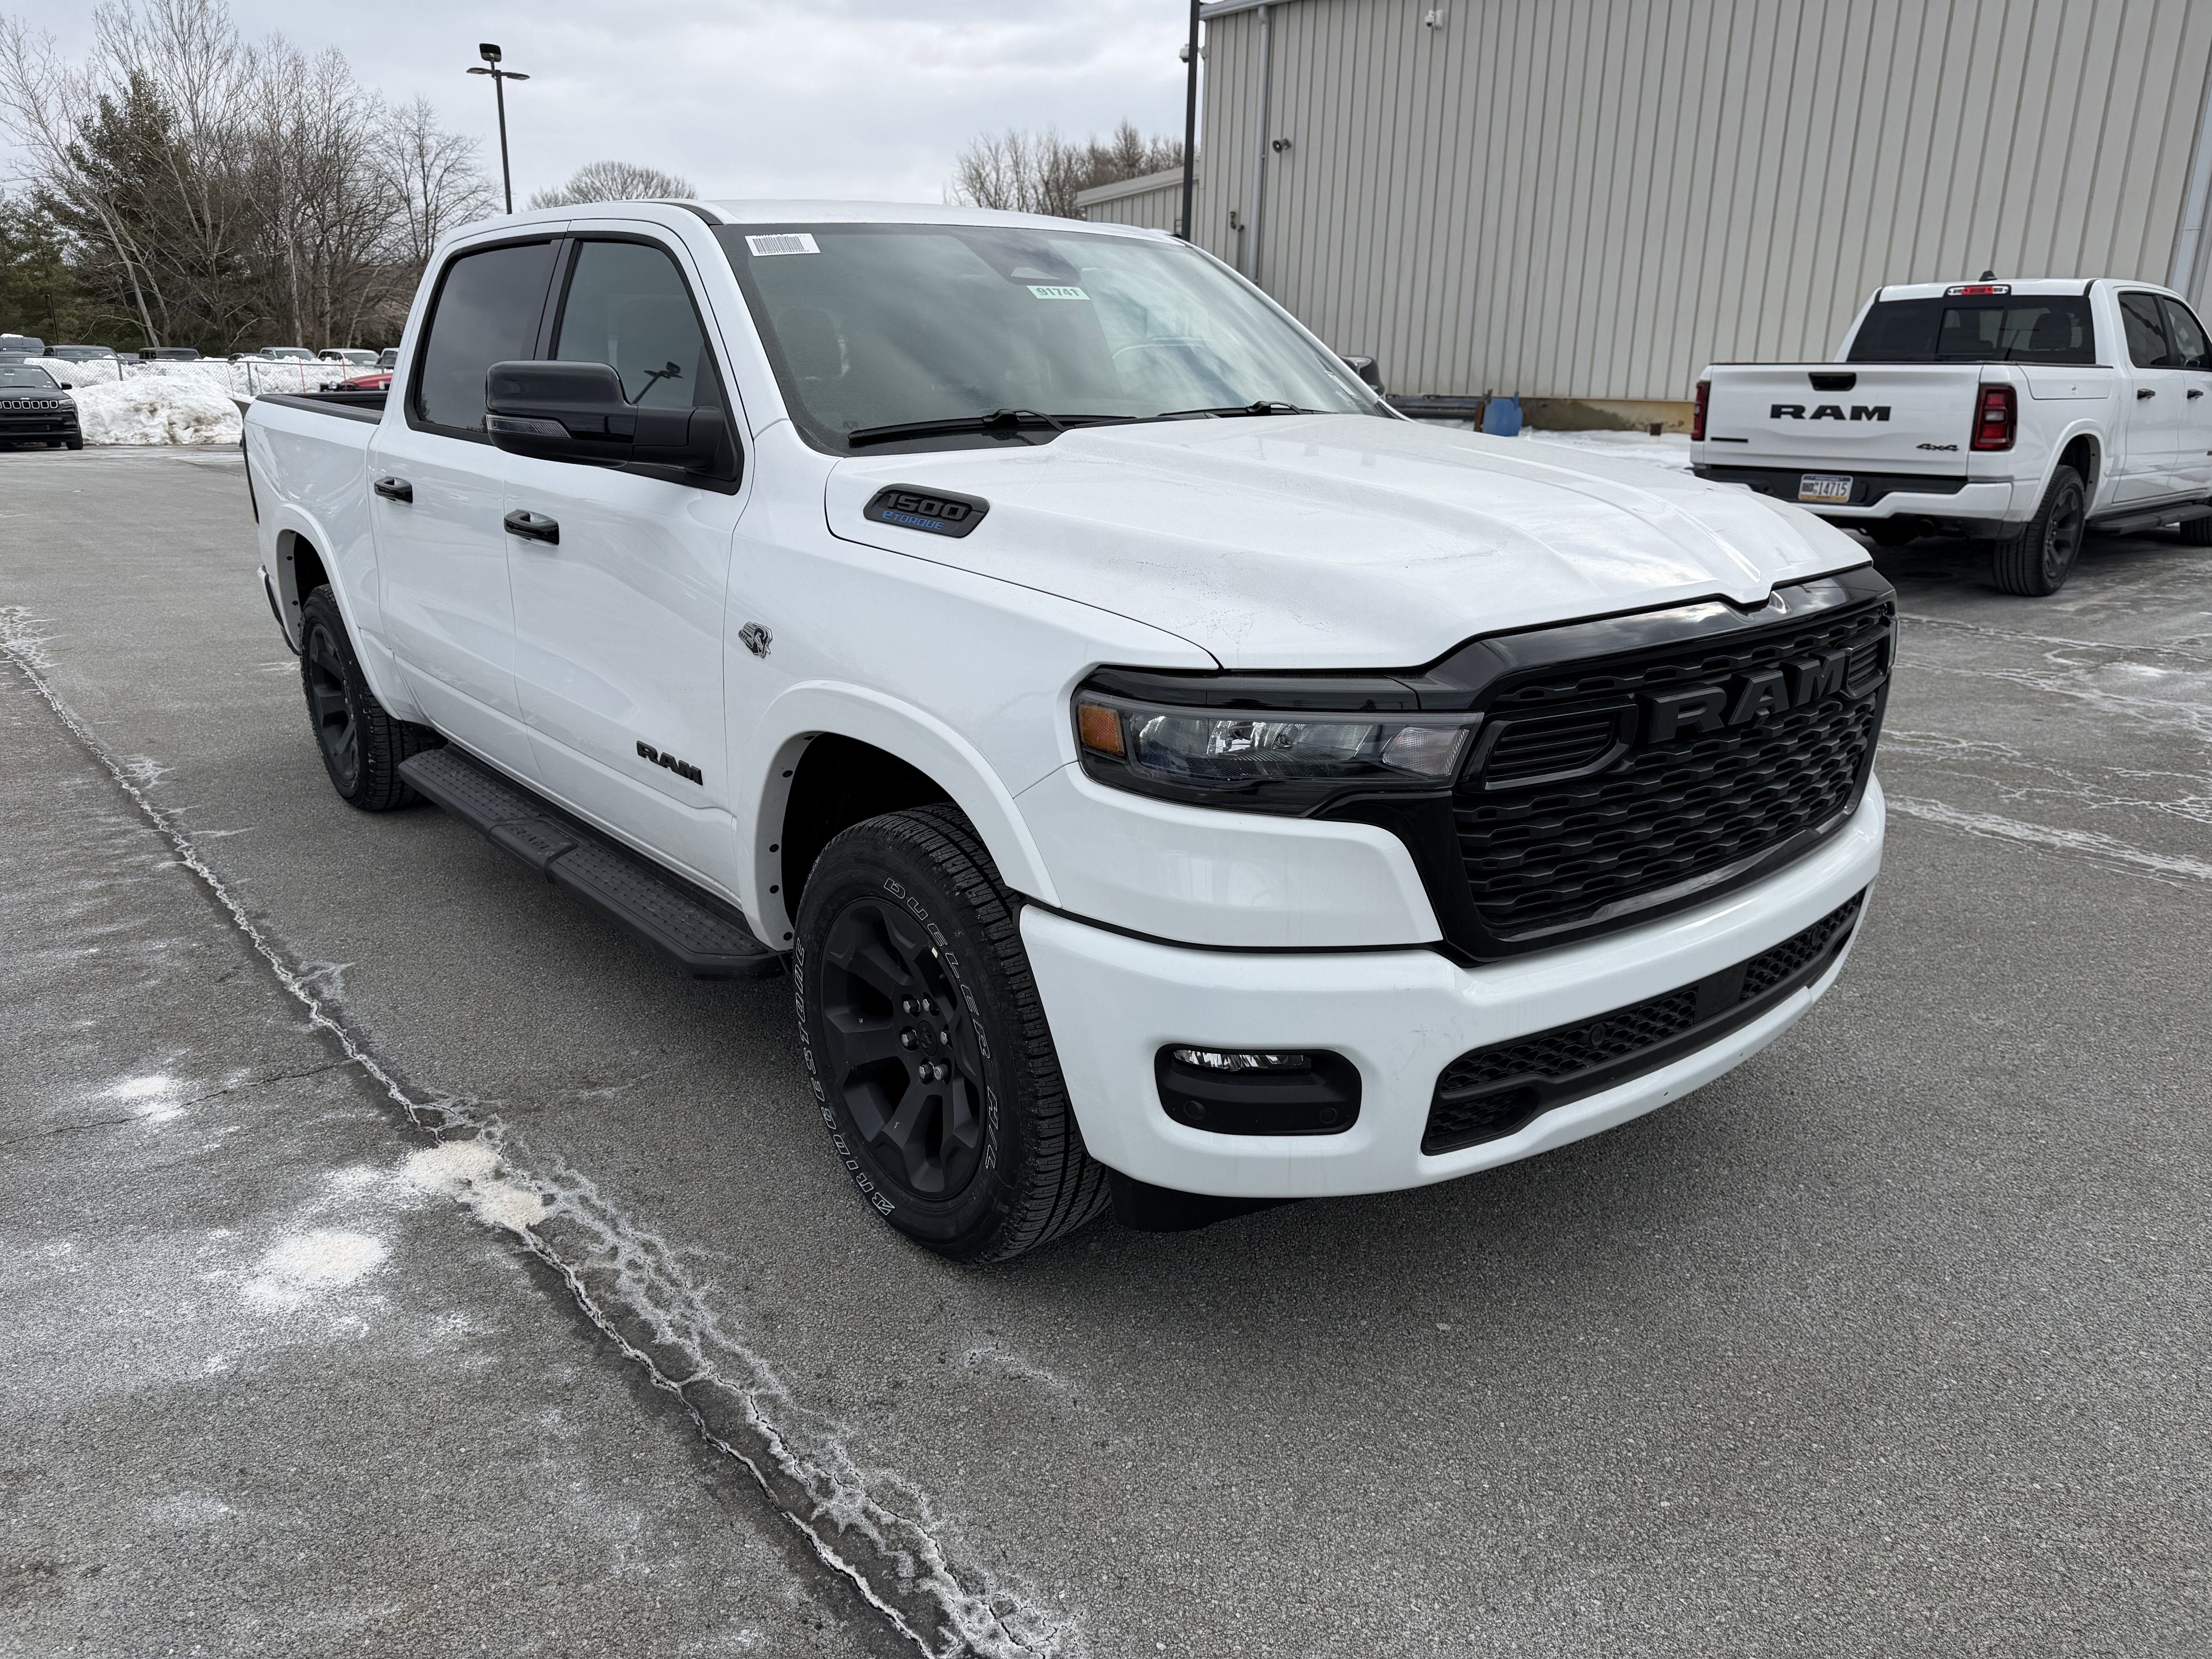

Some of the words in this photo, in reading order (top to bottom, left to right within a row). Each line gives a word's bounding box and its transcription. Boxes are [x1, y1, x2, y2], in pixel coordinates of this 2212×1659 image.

[1037, 288, 1080, 296] 91741
[1770, 404, 1891, 421] RAM
[1916, 444, 1959, 452] 4x4
[882, 510, 944, 529] eTORQUE
[888, 493, 969, 520] 1500
[1649, 651, 1846, 744] RAM
[637, 740, 703, 785] RAM
[884, 878, 990, 1058] DUELER
[985, 1085, 998, 1169] H/L
[795, 938, 895, 1216] BRIDGESTONE
